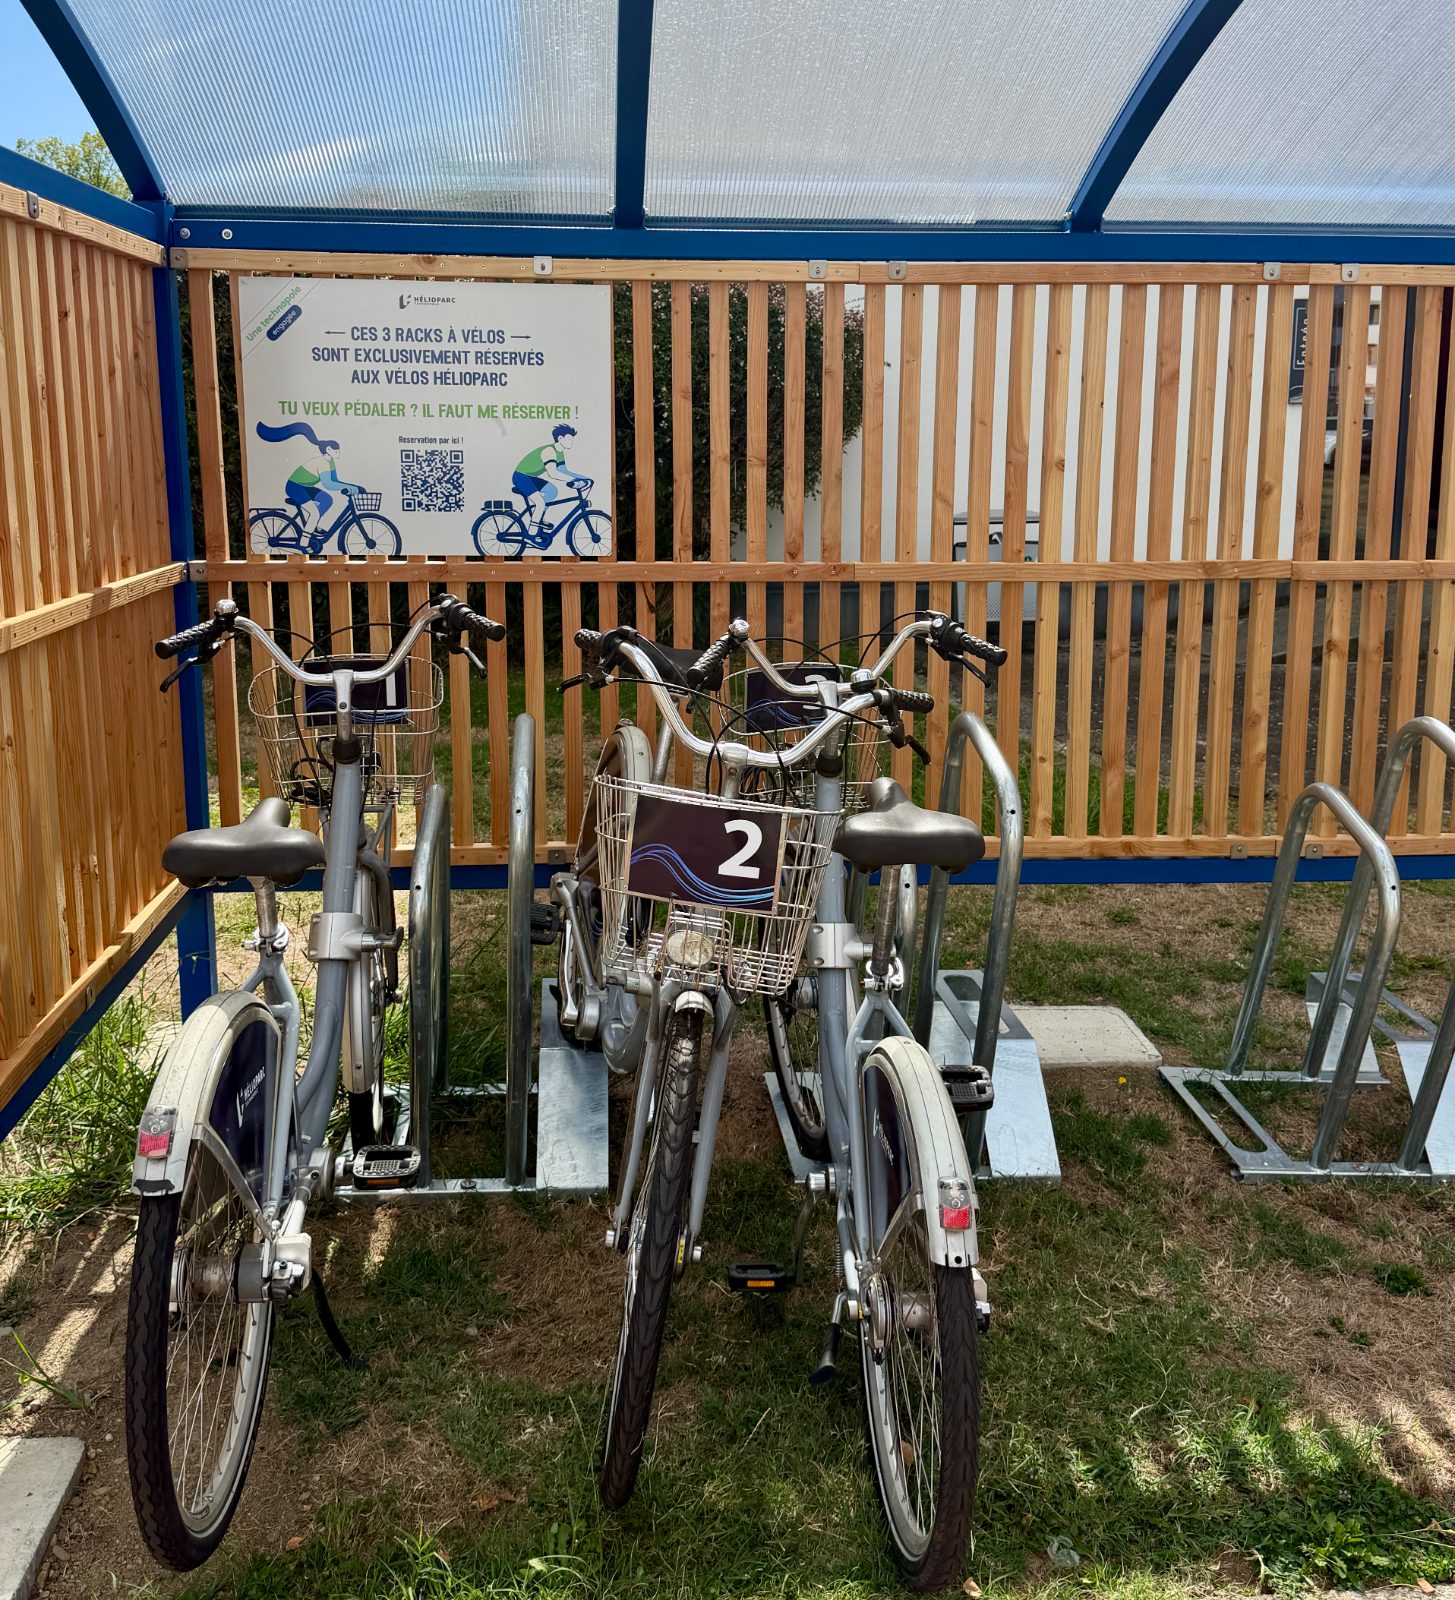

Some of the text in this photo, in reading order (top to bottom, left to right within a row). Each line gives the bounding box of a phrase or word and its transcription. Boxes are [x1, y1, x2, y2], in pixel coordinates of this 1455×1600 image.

[414, 295, 456, 303] HÉLIOPARC
[246, 286, 301, 341] Une technopole
[351, 325, 505, 344] CES 3 RACKS À VÉLOS
[312, 347, 545, 366] SONT EXCLUSIVEMENT RÉSERVÉS
[351, 367, 508, 387] AUX VÉLOS HÉLIOPARC
[278, 399, 579, 420] TU VEUX PÉDALER ? IL FAUT ME RÉSERVER !
[398, 435, 437, 444] Reservation
[439, 437, 449, 445] par
[451, 436, 459, 444] ici
[717, 819, 763, 879] 2
